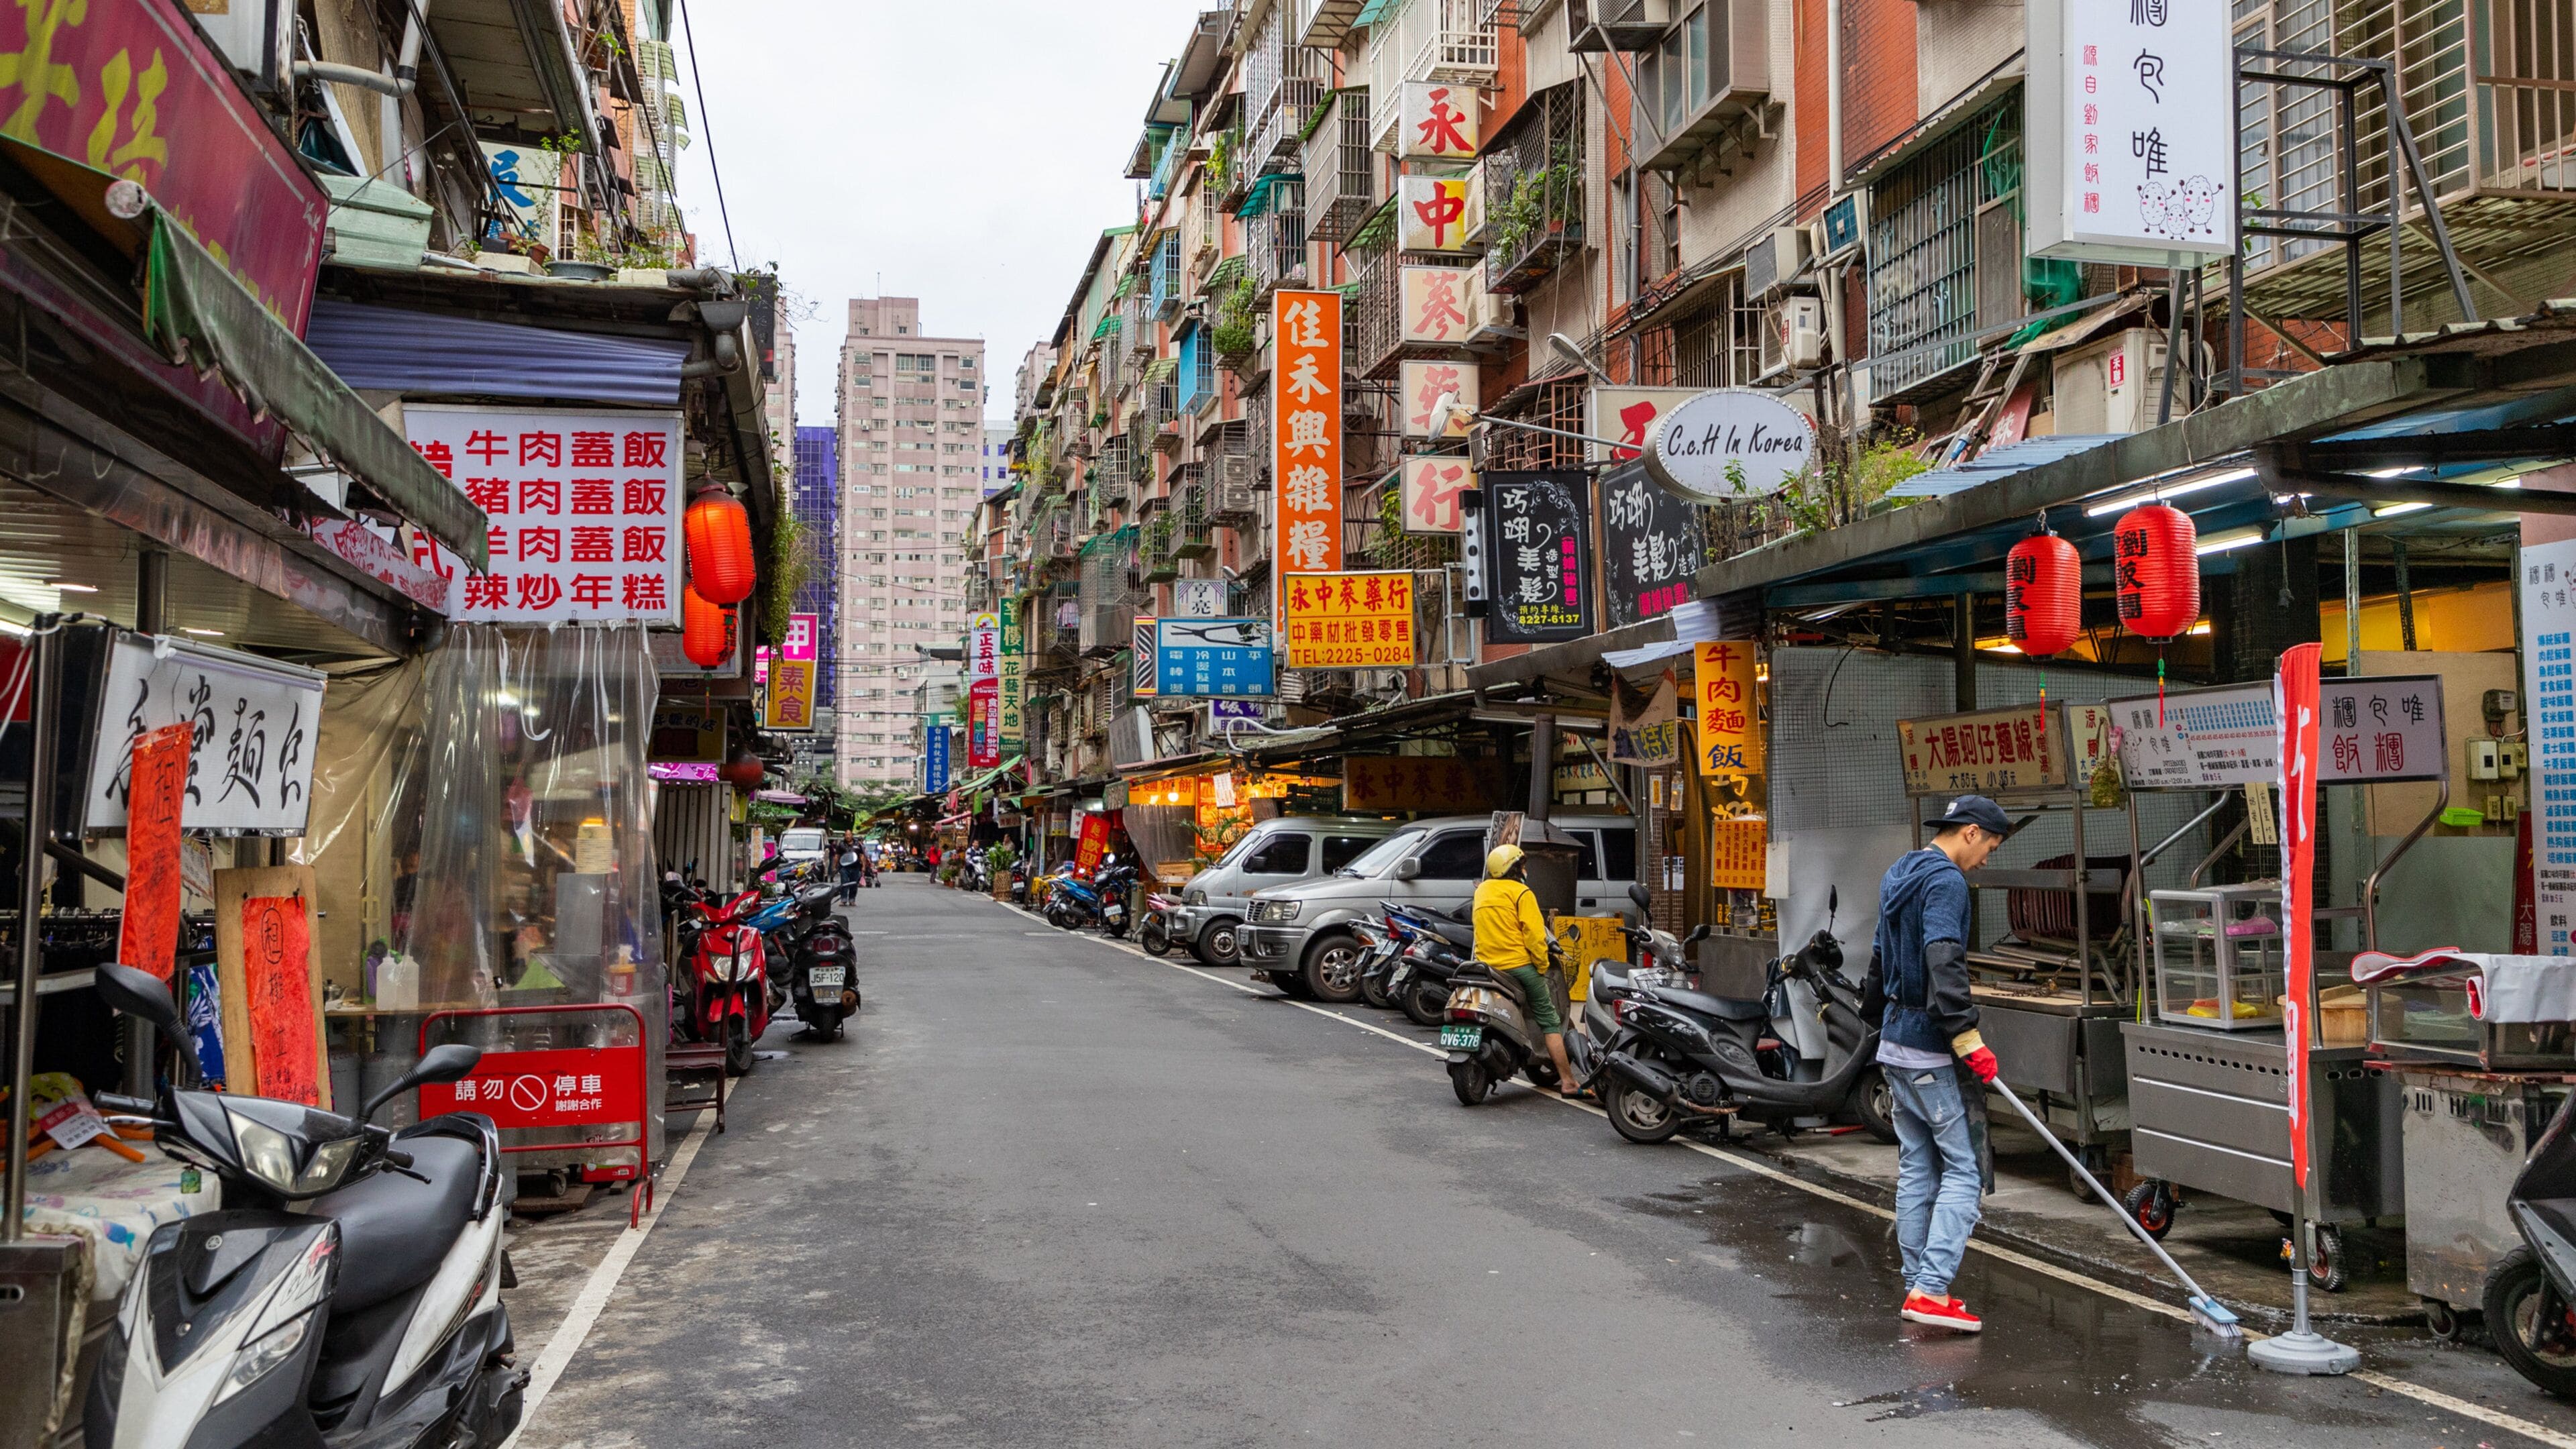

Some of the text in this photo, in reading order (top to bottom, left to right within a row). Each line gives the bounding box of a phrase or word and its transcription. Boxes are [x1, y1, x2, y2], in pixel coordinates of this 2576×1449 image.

[465, 430, 666, 468] 牛肉蓋飯
[1283, 299, 1333, 570] 佳禾興雜糧
[1725, 424, 1740, 455] In
[1748, 423, 1803, 453] Korea
[465, 477, 666, 515] 豬肉蓋飯
[1545, 548, 1559, 579] 造型
[1679, 550, 1697, 577] 造型
[465, 572, 666, 610] 辣炒年糕
[1291, 576, 1409, 614] 永中蔘藥行
[1292, 619, 1409, 645] 中藥材批發零售
[1519, 614, 1580, 625] 8227-6137
[1222, 650, 1236, 693] 山本頭
[1248, 650, 1262, 693] 平頭
[1293, 646, 1411, 664] TEL:2225-0284
[777, 665, 805, 723] 素食
[1004, 661, 1020, 727] 花藝天地
[1705, 644, 1748, 770] 牛肉麵飯
[1925, 718, 2035, 771] 大腸蚵仔麵線
[2550, 914, 2567, 926] 飲料
[1440, 1033, 1480, 1047] QV6-378
[455, 1074, 602, 1101] 請勿 停車
[555, 1098, 602, 1112] 謝謝合作
